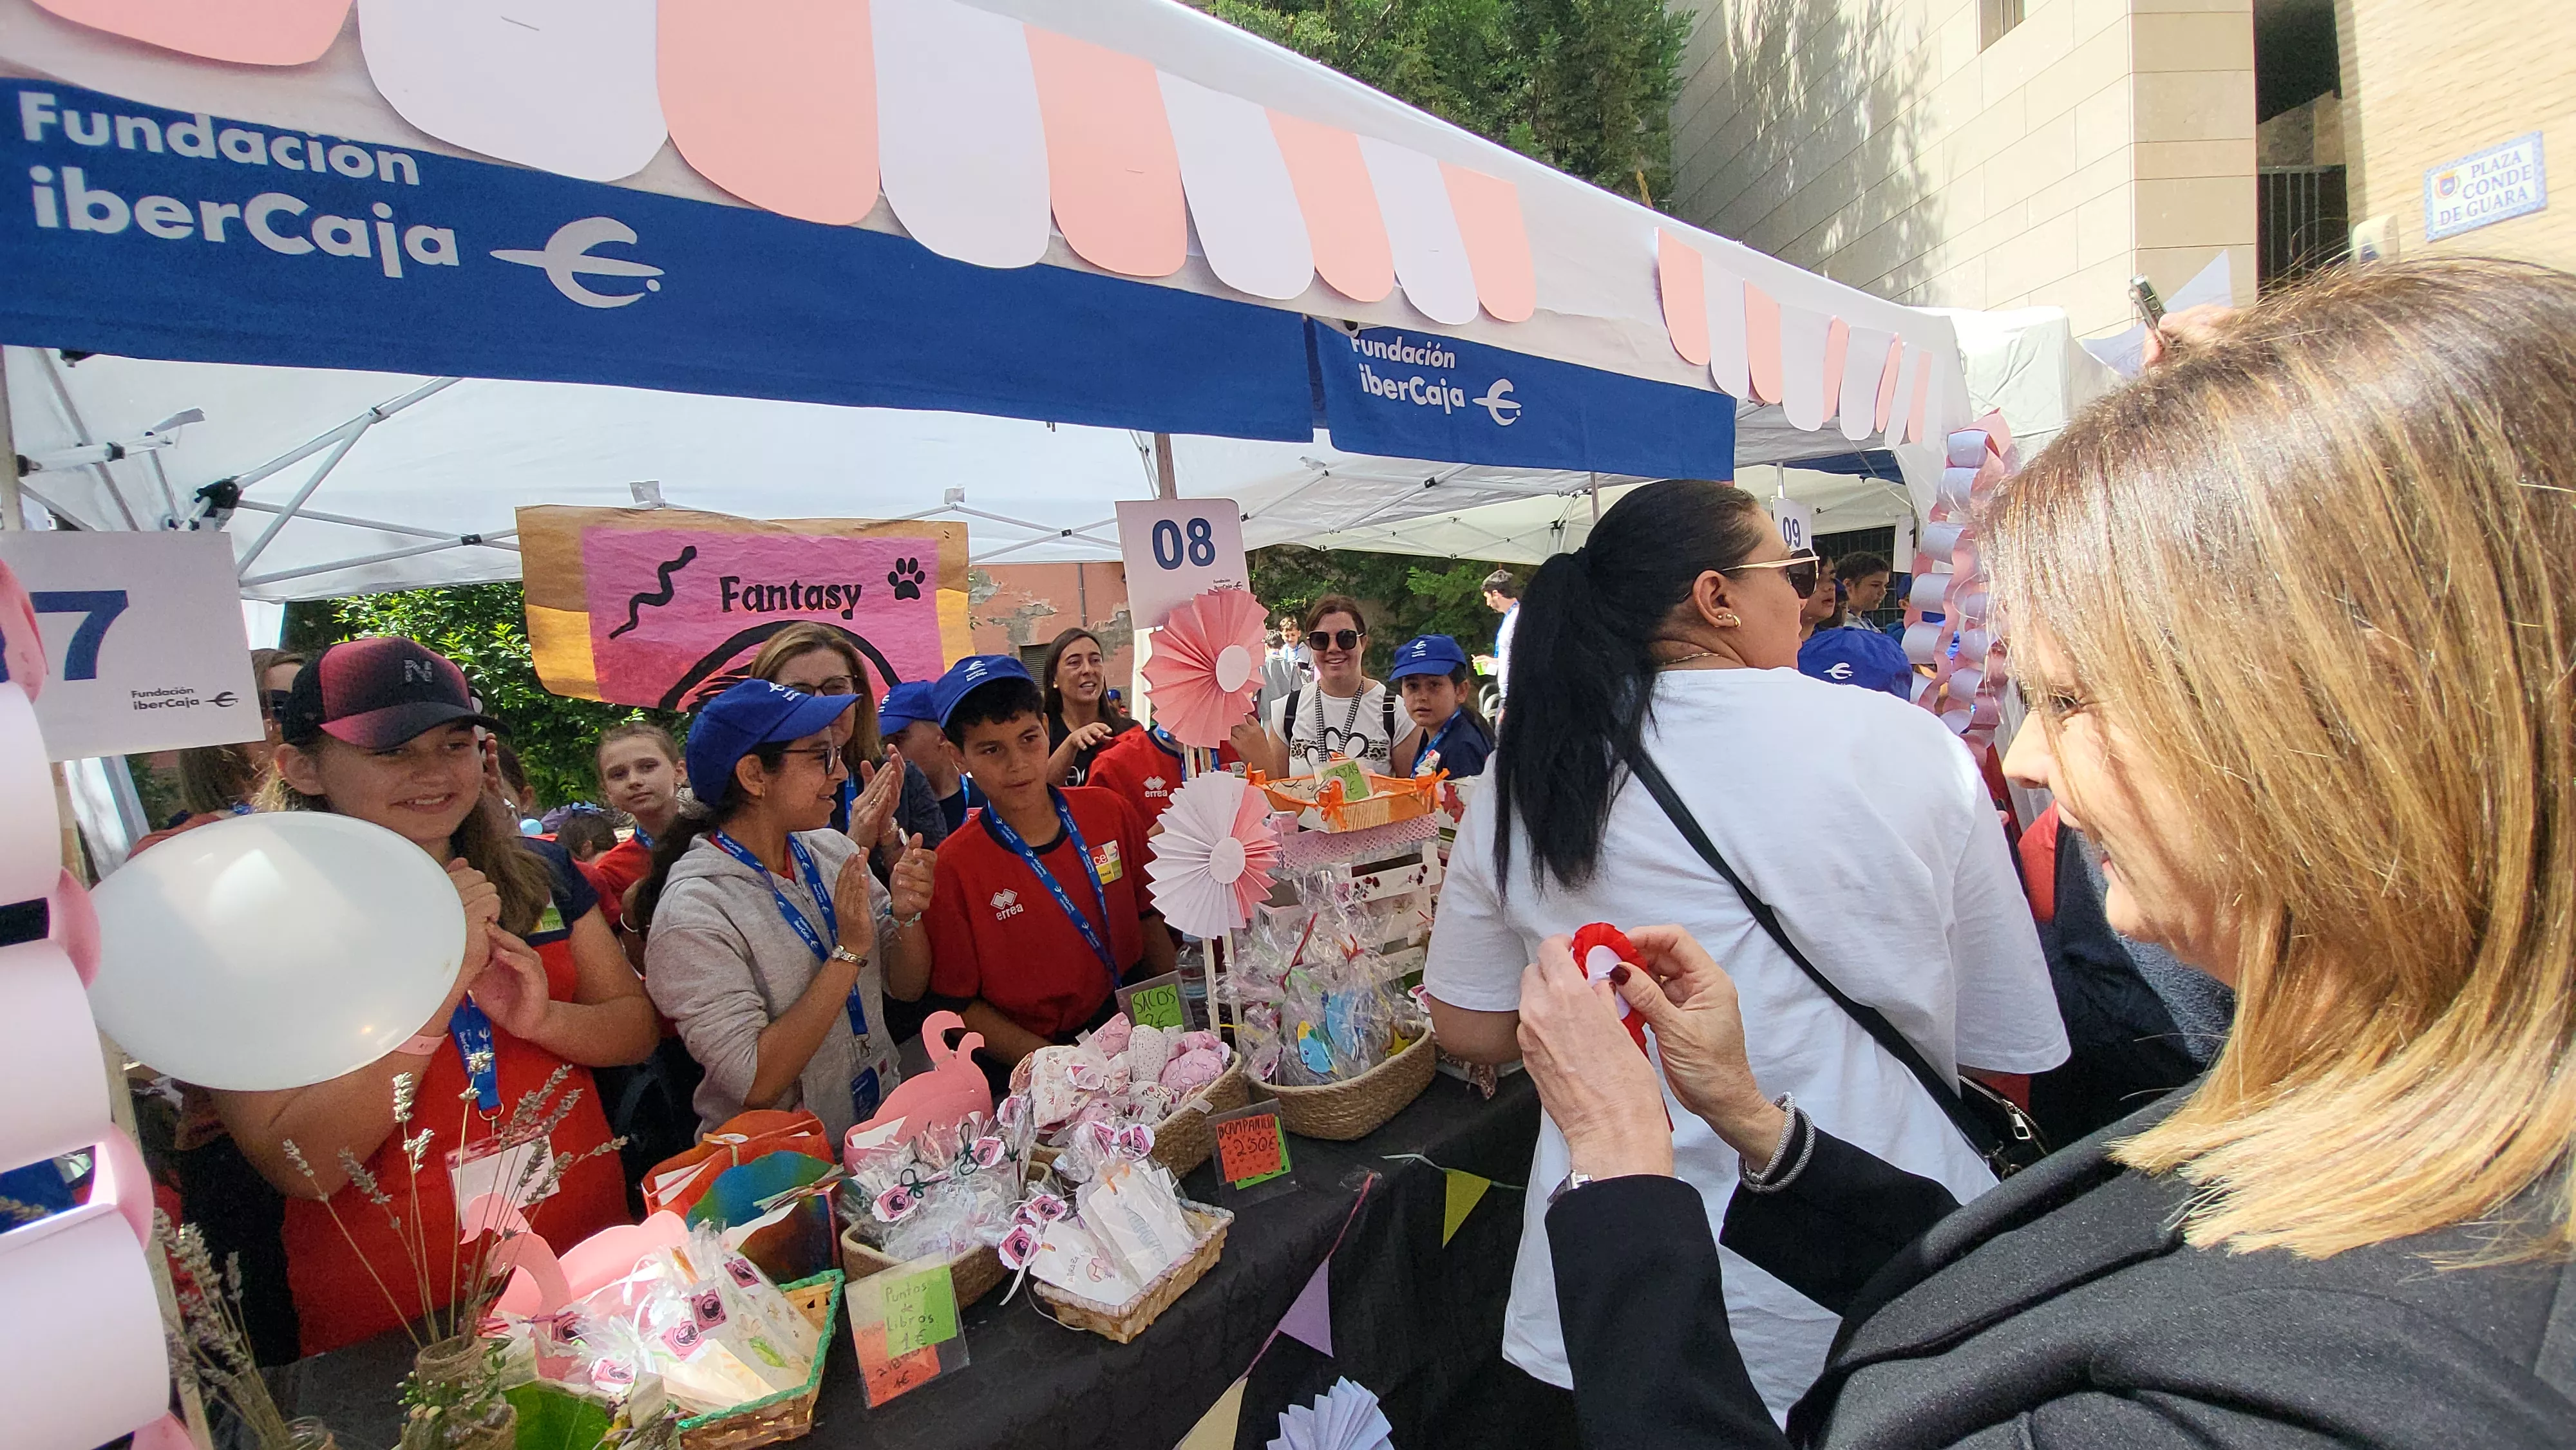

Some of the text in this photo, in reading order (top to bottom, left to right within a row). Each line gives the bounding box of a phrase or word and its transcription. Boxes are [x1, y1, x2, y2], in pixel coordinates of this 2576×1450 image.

[2470, 150, 2523, 179] PLAZA
[2462, 164, 2532, 200] CONDE
[2439, 186, 2529, 226] DE GUARA
[30, 167, 460, 278] iberCaja
[1350, 335, 1455, 369] Fundación
[1358, 362, 1466, 414] iberCaja
[1151, 517, 1217, 570] 08
[1783, 516, 1801, 548] 09
[719, 576, 862, 620] Fantasy
[131, 686, 194, 699] Fundación
[133, 697, 200, 711] iberCaja
[1145, 789, 1168, 798] errea
[1094, 854, 1107, 865] ce
[996, 903, 1024, 921] errea
[1133, 986, 1176, 1014] SACOS
[901, 1303, 913, 1312] de
[886, 1315, 934, 1332] Libros
